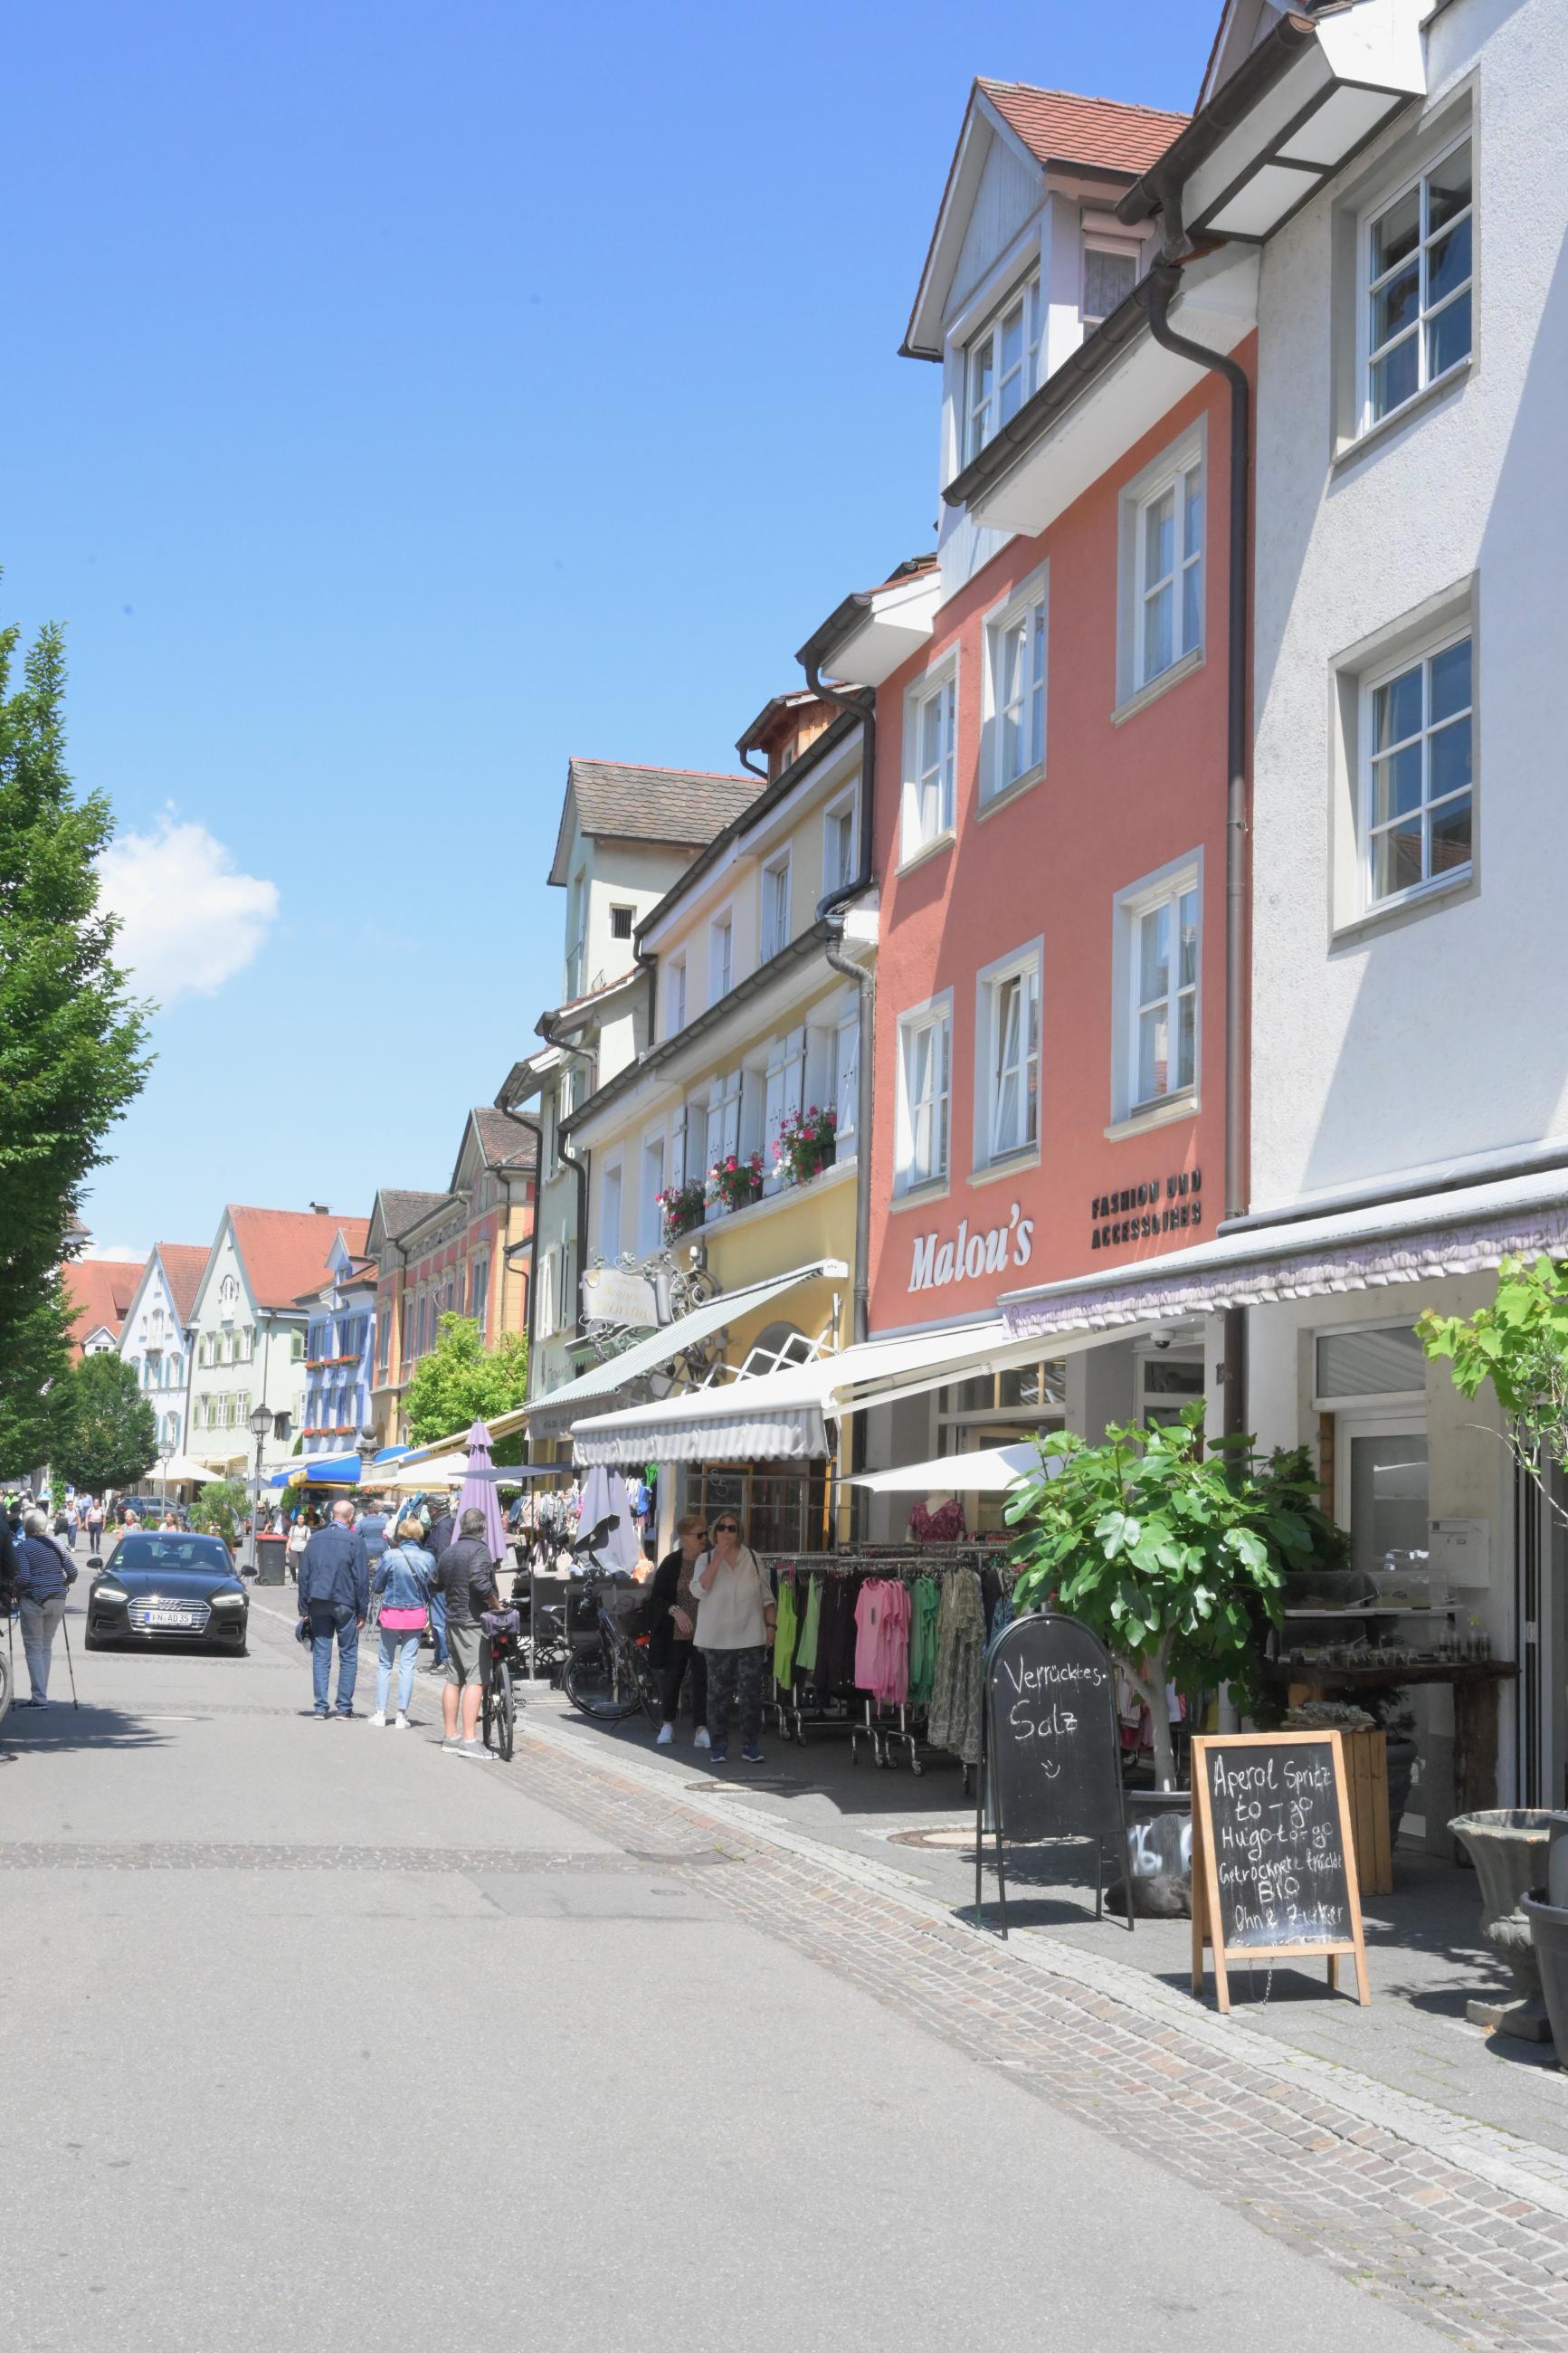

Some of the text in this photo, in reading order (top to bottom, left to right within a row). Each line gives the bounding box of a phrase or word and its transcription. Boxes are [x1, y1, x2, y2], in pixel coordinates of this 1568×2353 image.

[1092, 1170, 1201, 1220] FASHION UND
[1091, 1201, 1201, 1249] ACCESSOIRES
[908, 1202, 1033, 1292] Malou's
[179, 1615, 189, 1623] 35
[1004, 1653, 1102, 1693] Verrücktes
[1010, 1699, 1078, 1739] Salz
[1214, 1754, 1332, 1798] Aperol Spritz
[1259, 1876, 1300, 1904] BIO
[1235, 1904, 1278, 1931] Ohne
